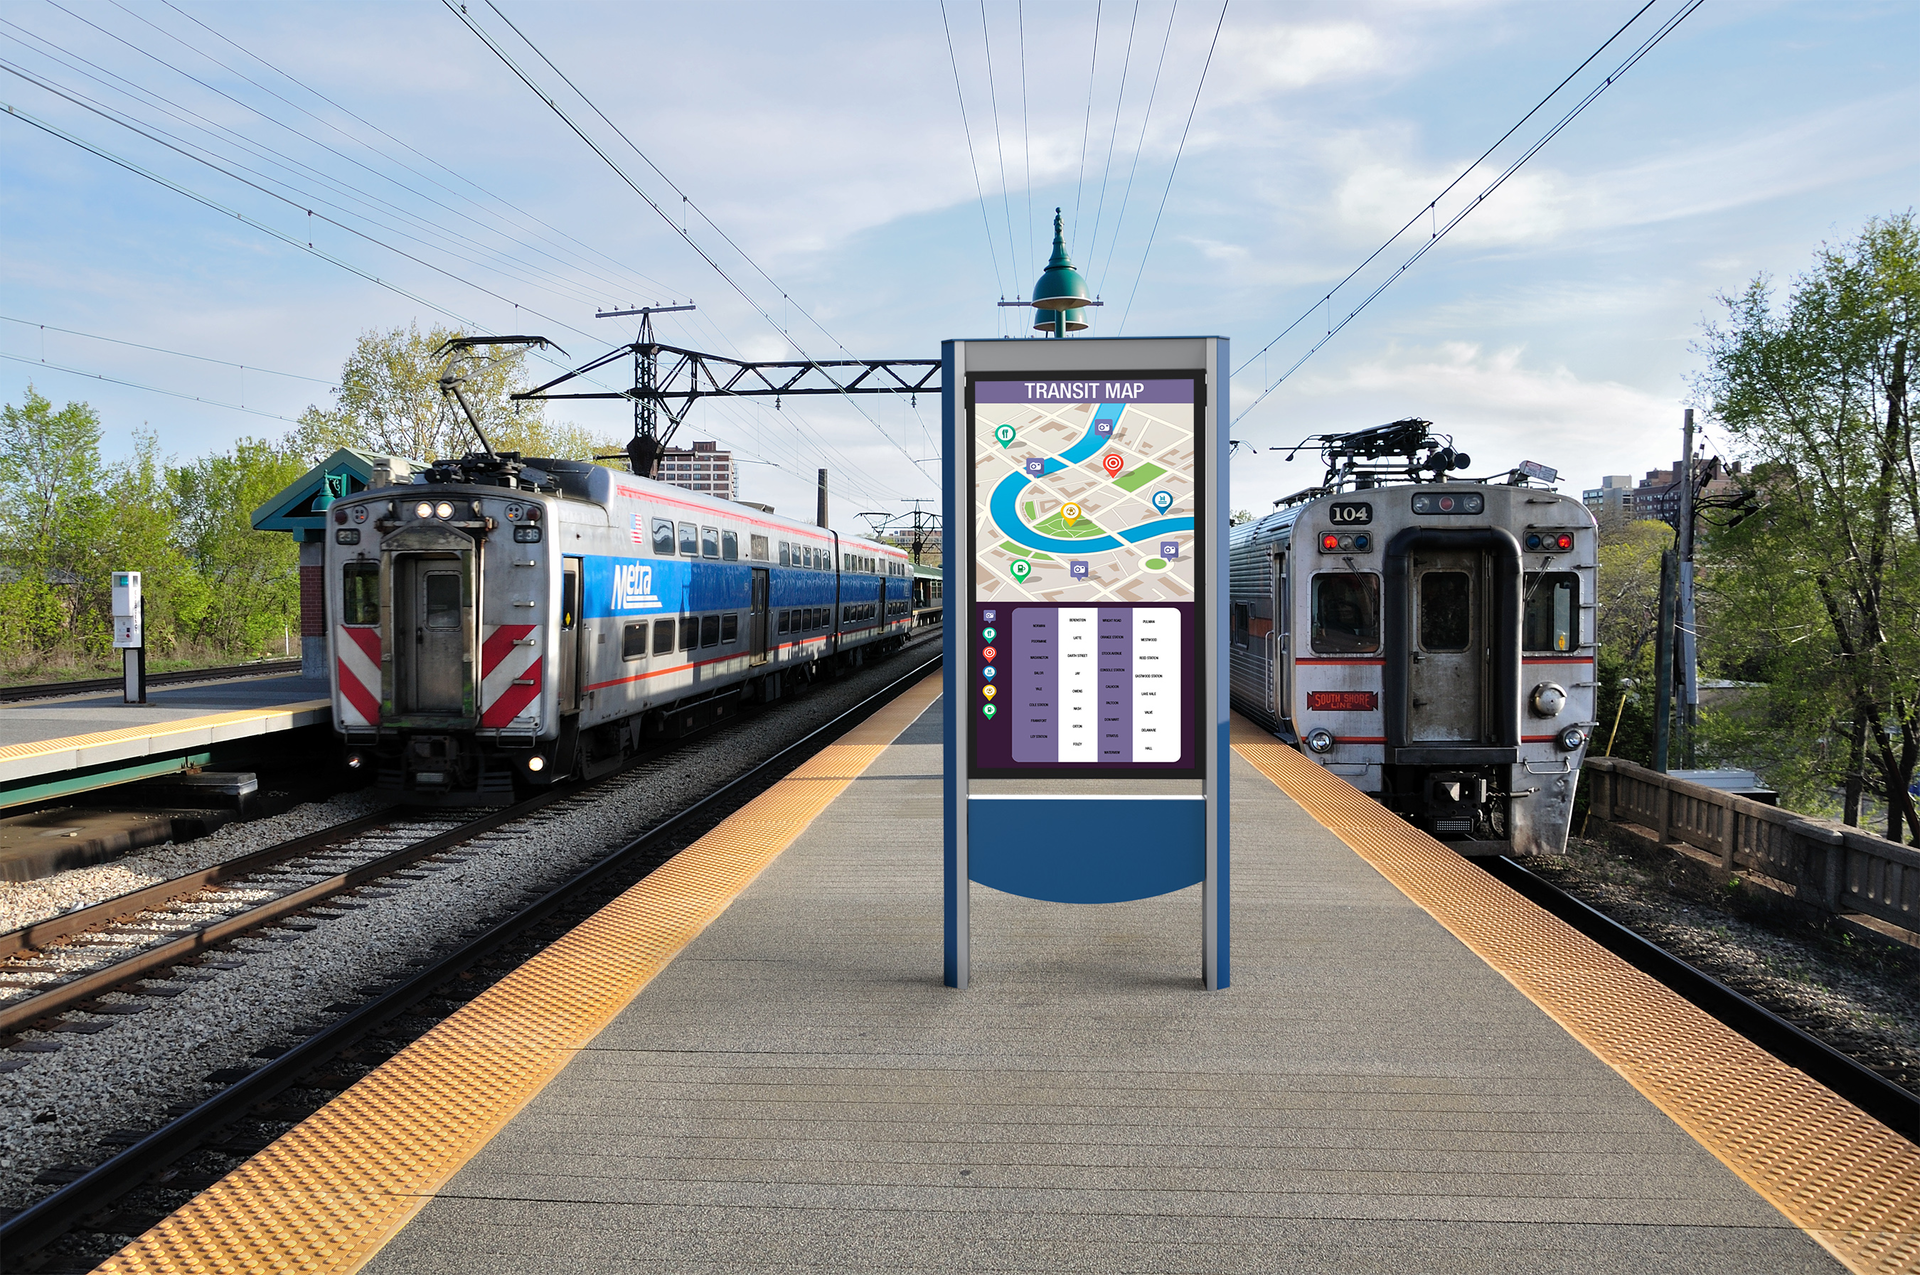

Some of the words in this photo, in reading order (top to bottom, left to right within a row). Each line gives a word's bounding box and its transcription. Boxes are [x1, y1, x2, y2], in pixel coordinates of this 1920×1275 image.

[1024, 382, 1100, 399] TRANSIT
[1105, 382, 1145, 399] MAP
[1332, 506, 1369, 521] 104
[517, 529, 539, 540] 236
[611, 560, 657, 610] Metra
[1315, 693, 1341, 707] SOUTH
[1344, 693, 1370, 708] SHORE
